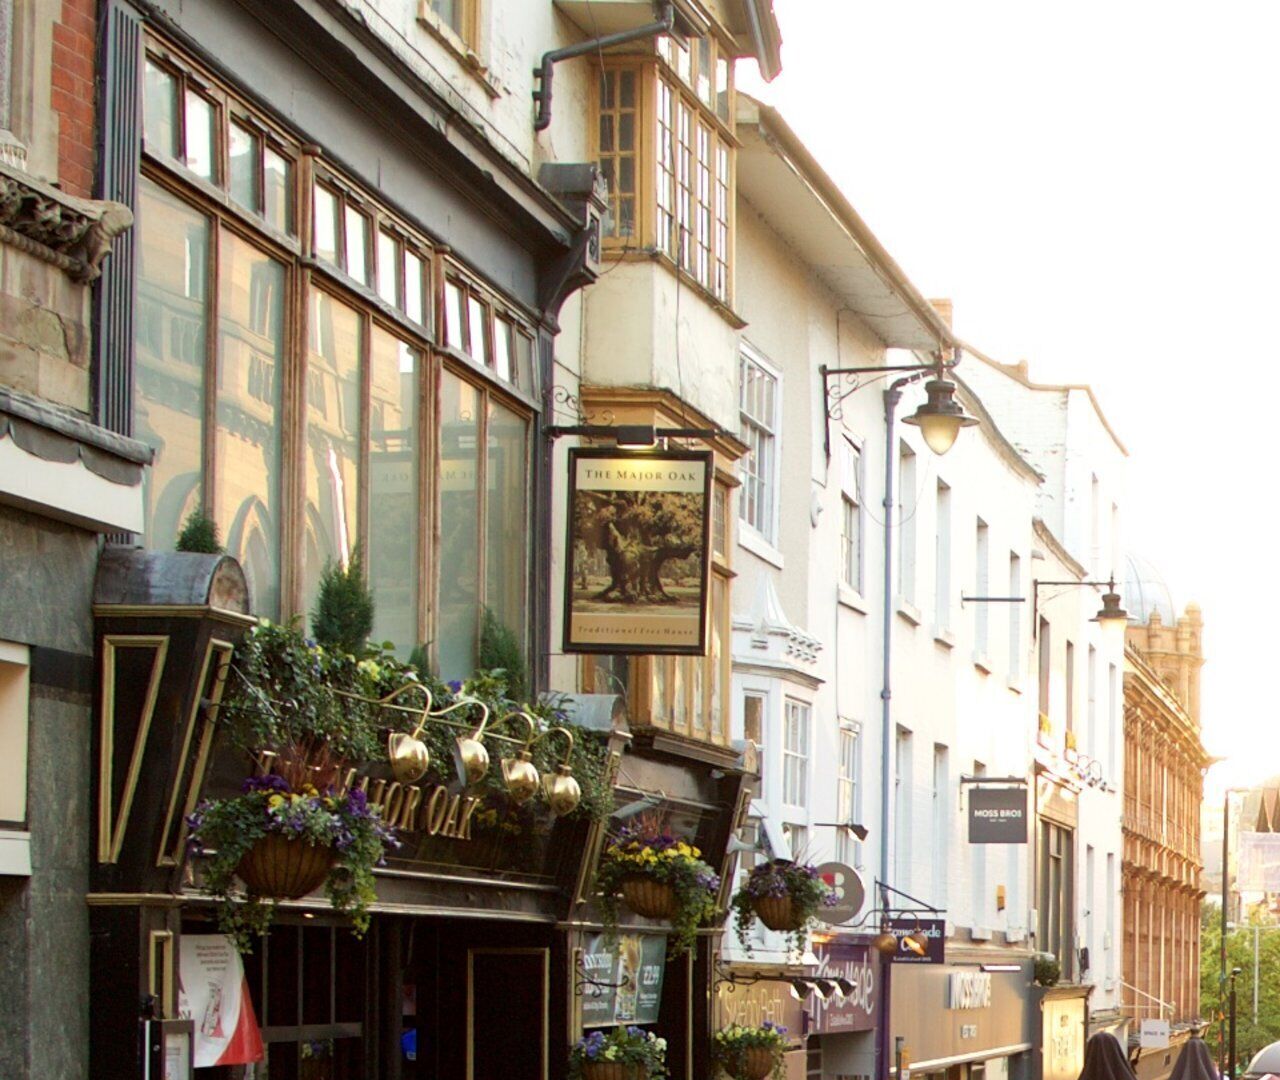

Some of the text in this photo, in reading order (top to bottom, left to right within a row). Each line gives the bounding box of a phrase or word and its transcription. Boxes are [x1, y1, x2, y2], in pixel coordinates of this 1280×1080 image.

[585, 469, 697, 482] THE MAJOR OAK
[578, 626, 638, 635] Traditional
[428, 785, 481, 841] OAK
[974, 809, 999, 818] MOSS
